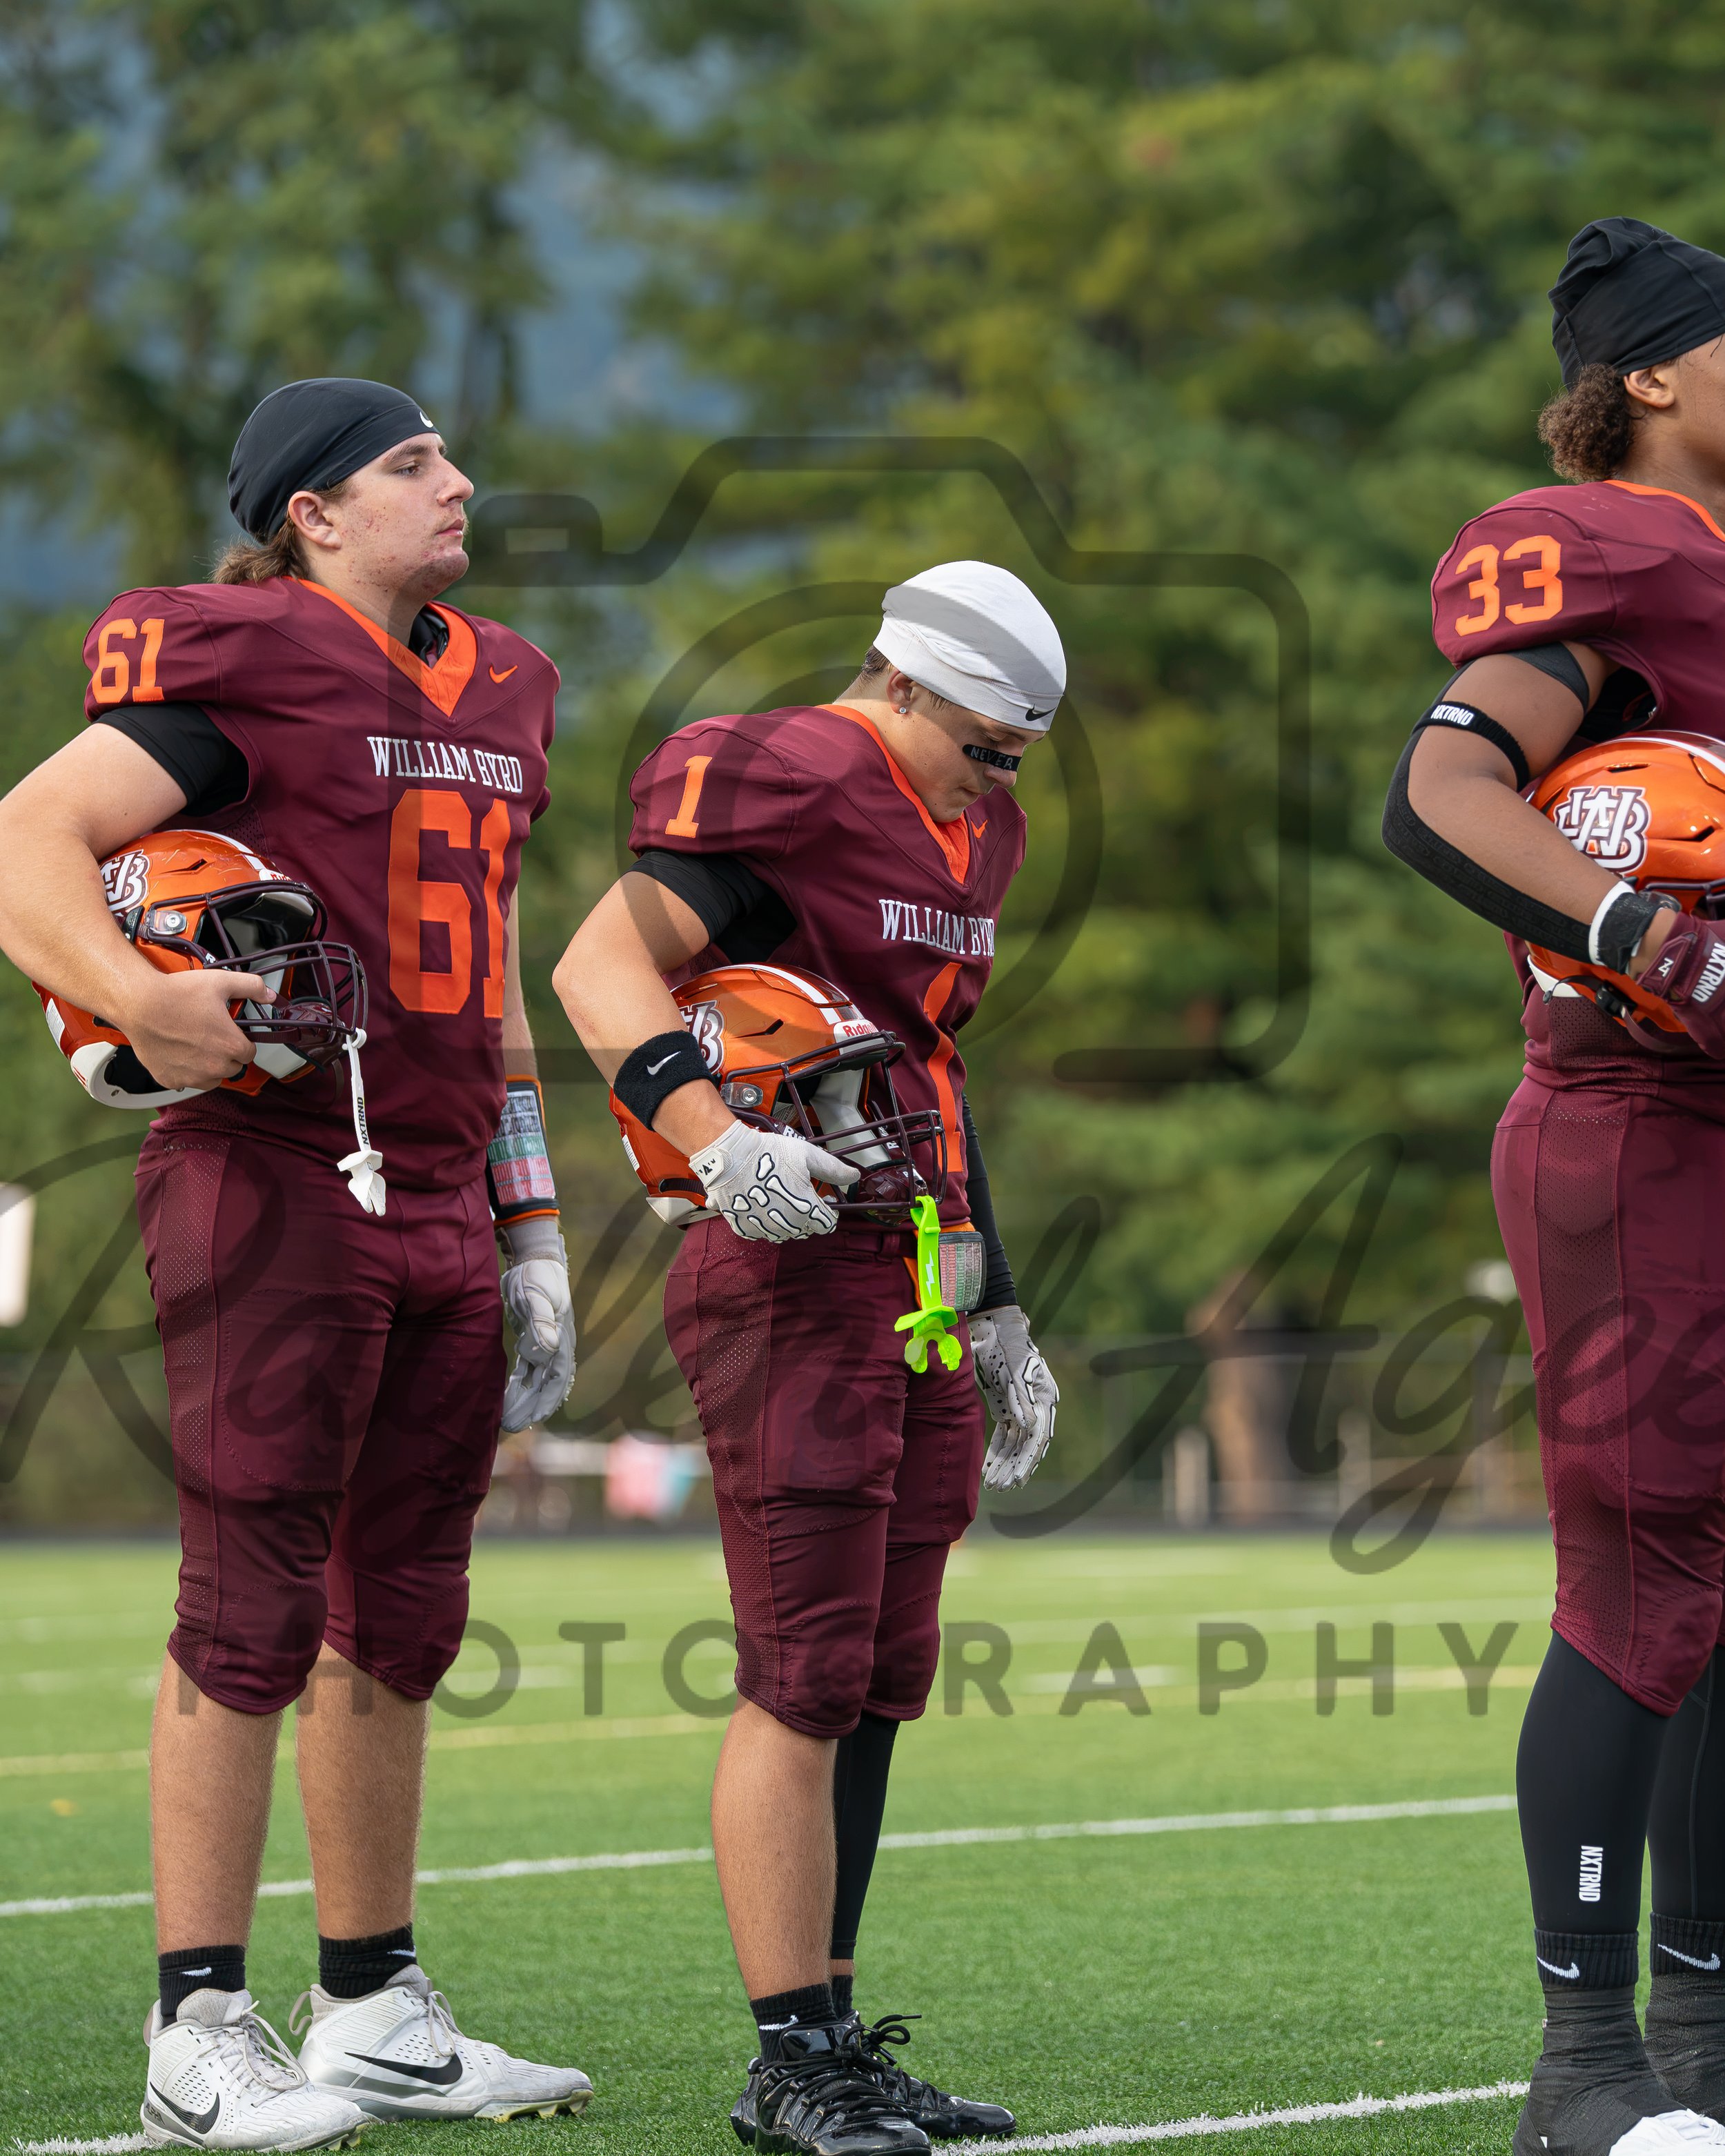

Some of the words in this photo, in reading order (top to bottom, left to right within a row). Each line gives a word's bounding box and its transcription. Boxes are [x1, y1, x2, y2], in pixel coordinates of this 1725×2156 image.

[1455, 535, 1562, 636] 33
[92, 618, 166, 703] 61
[1430, 704, 1474, 725] NXTRND
[367, 736, 476, 782] WILLIAM
[473, 749, 523, 794] BYRD
[970, 746, 1013, 770] NEVER
[664, 755, 712, 838] 1
[388, 789, 511, 1019] 61
[878, 899, 966, 955] WILLIAM
[923, 962, 963, 1173] 1
[357, 1096, 370, 1145] NXTRND
[1579, 1845, 1604, 1902] NXTRND
